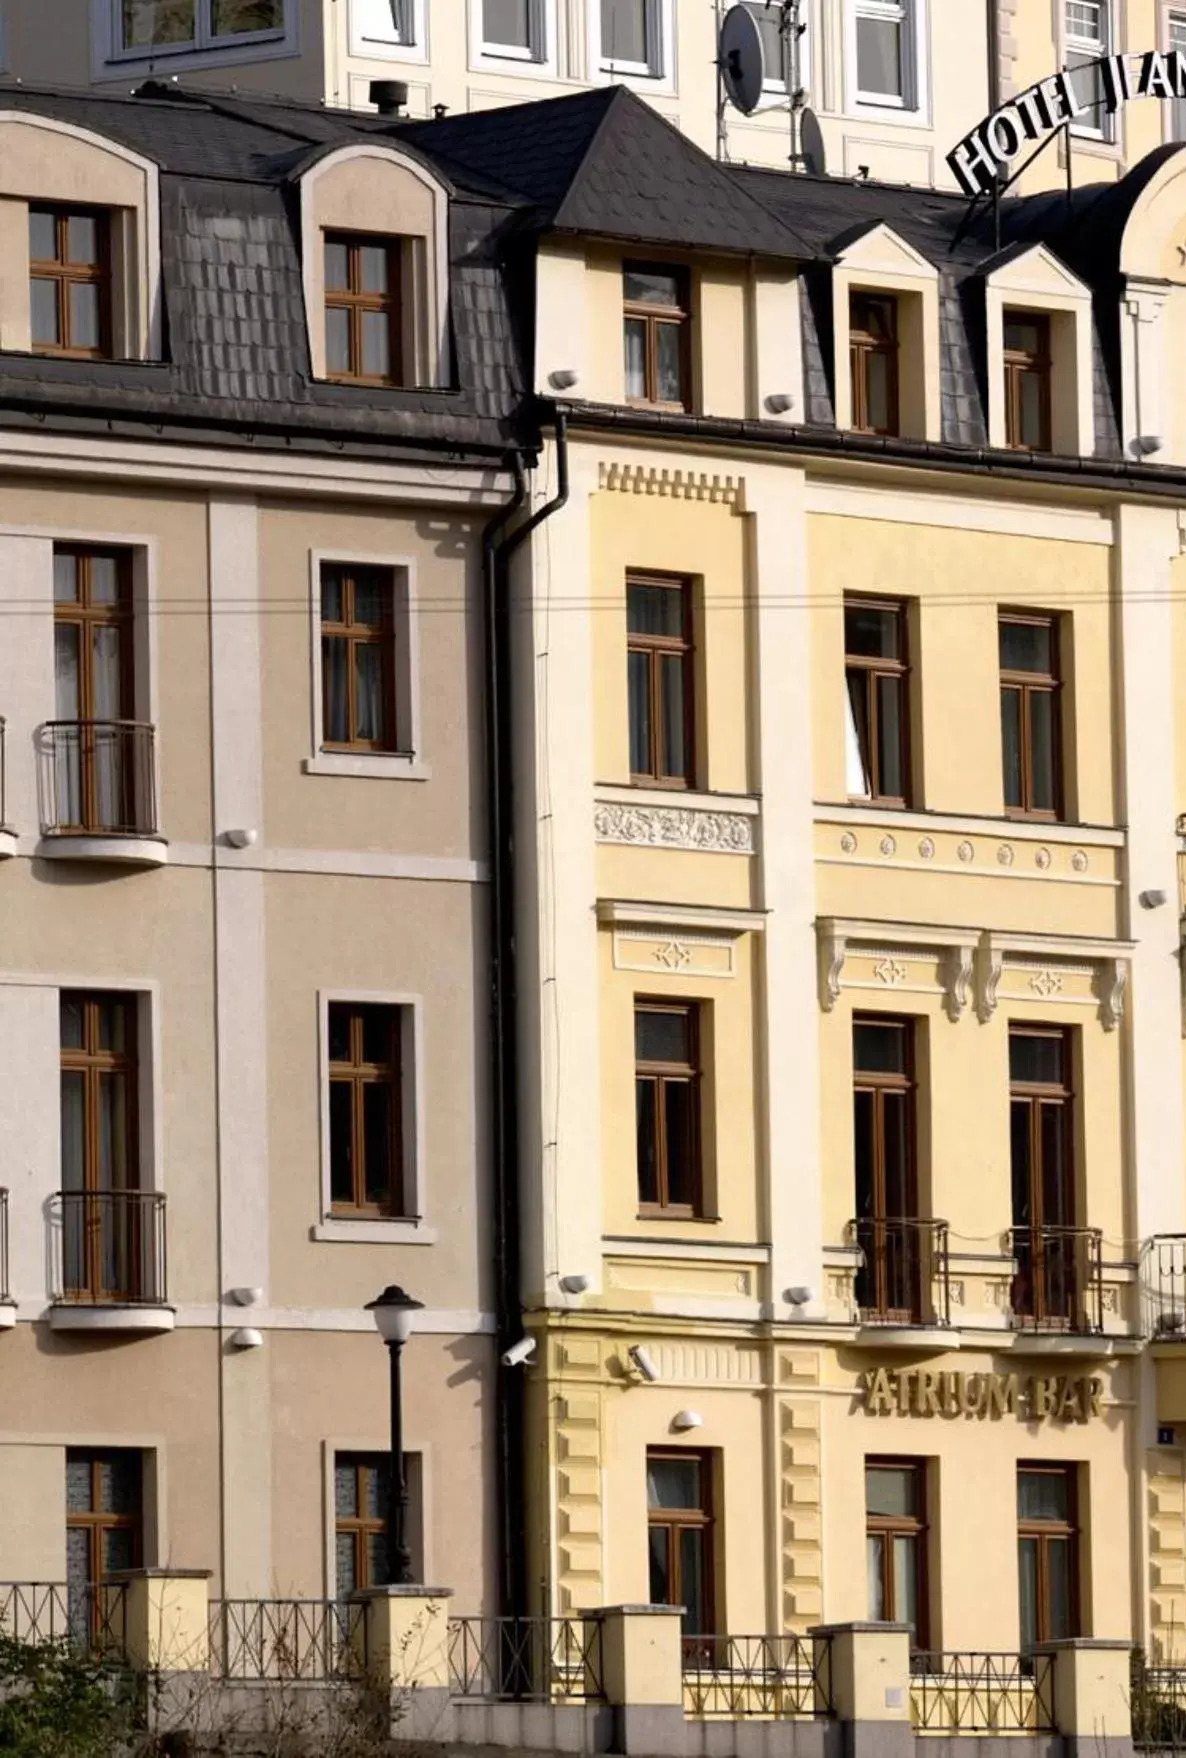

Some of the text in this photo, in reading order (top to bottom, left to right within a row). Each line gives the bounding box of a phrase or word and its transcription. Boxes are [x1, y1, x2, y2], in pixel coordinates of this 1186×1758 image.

[951, 71, 1090, 195] HOTEL
[868, 1367, 1104, 1418] ATRIUM BAR
